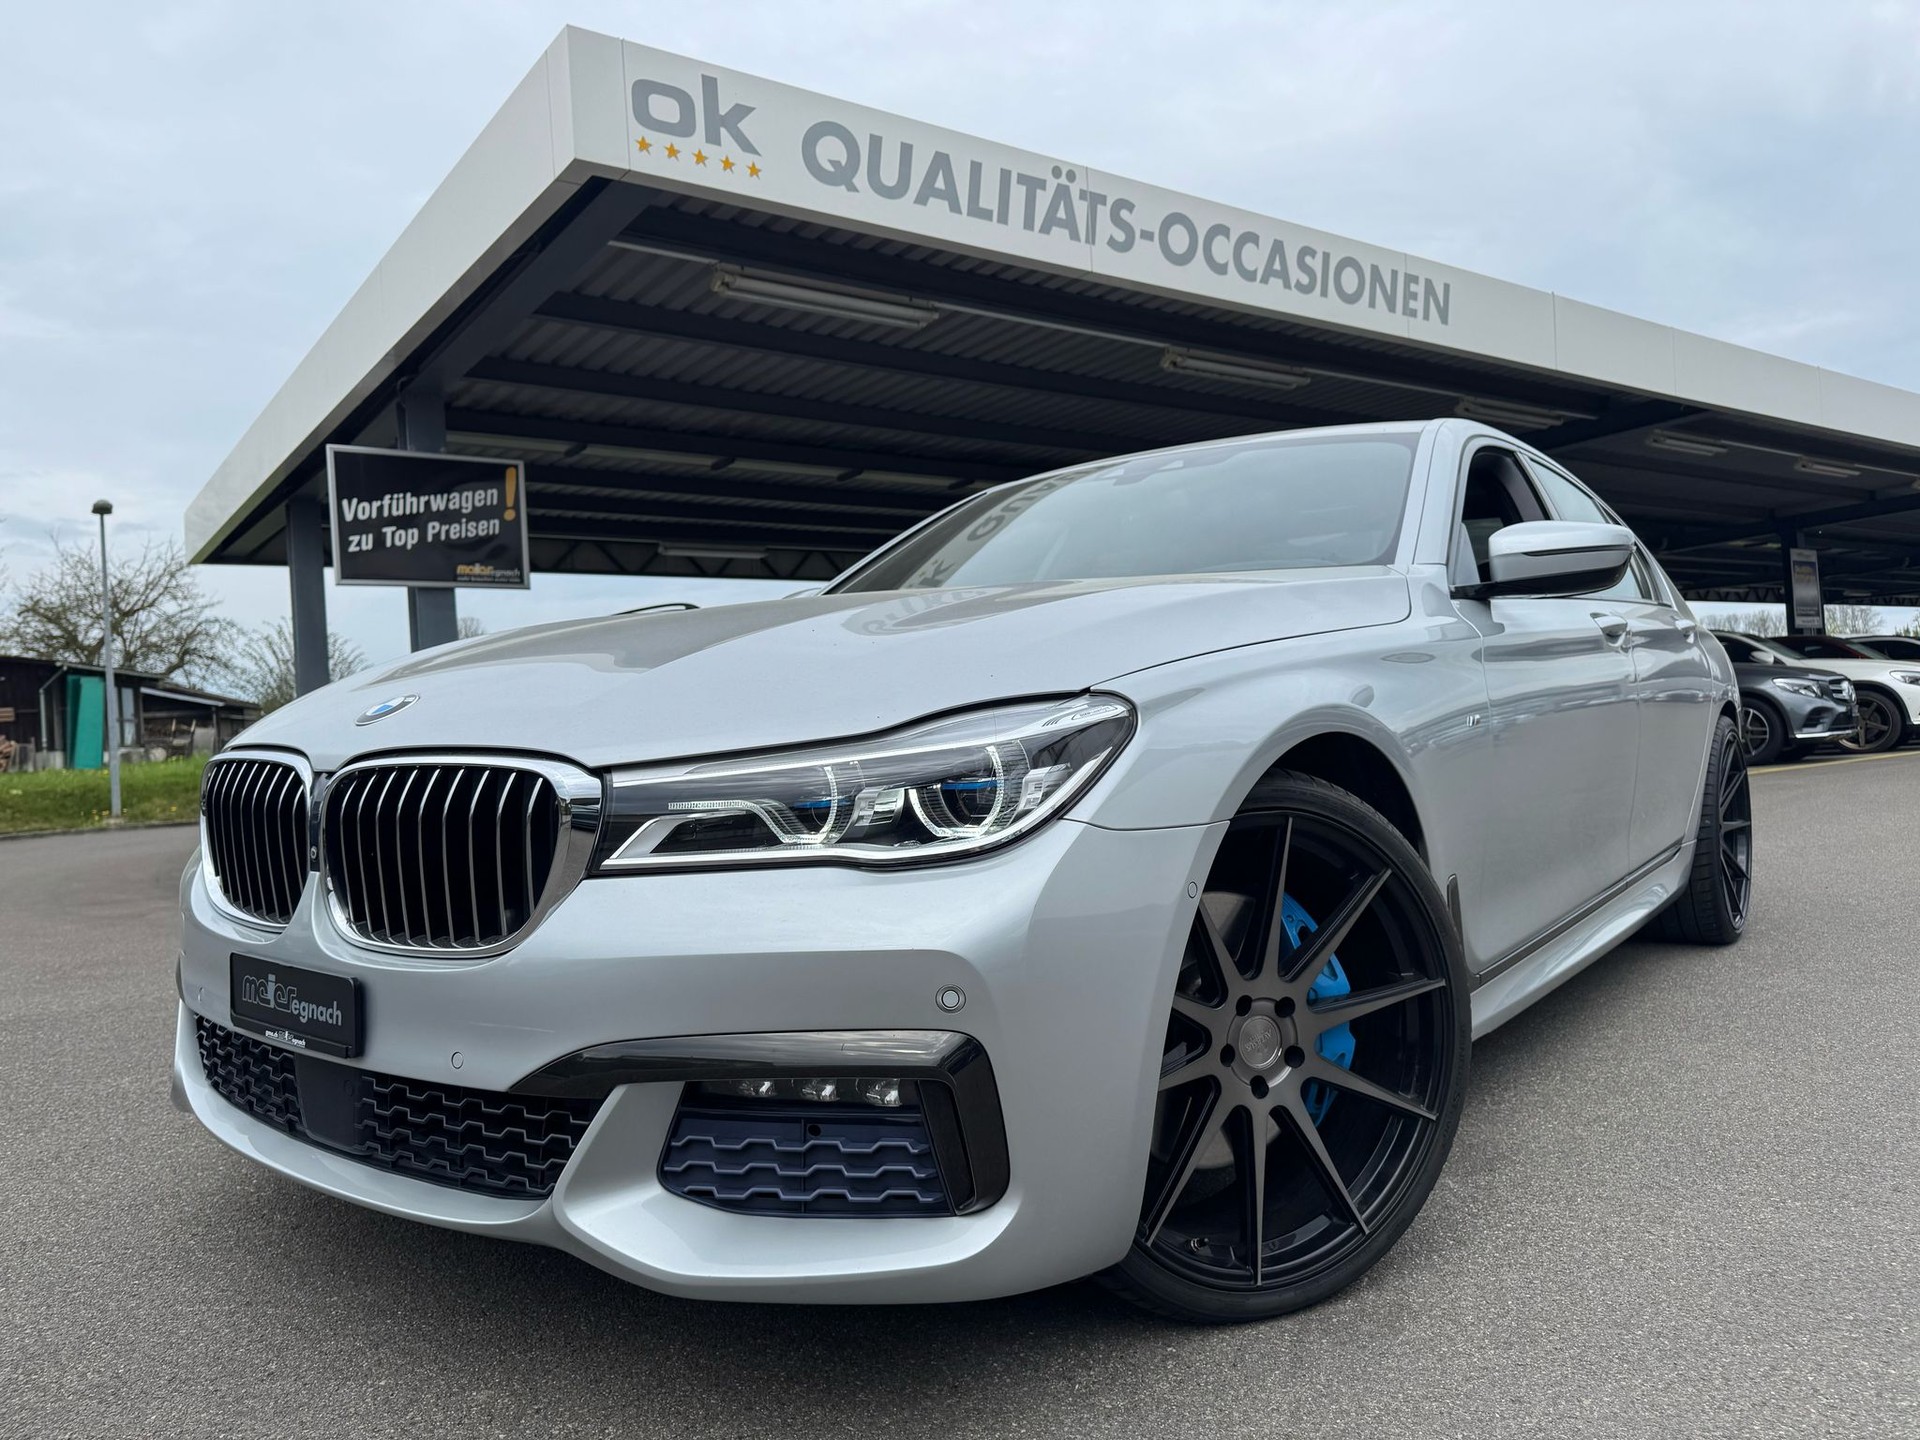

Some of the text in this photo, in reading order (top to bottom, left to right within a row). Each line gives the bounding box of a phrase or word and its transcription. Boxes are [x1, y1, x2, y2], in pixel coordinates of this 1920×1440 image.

[631, 73, 762, 156] ok
[801, 120, 1452, 326] QUALITÄTS-OCCASIONEN
[342, 487, 499, 522] Vorführwagen
[347, 517, 500, 553] zu Top Preisen
